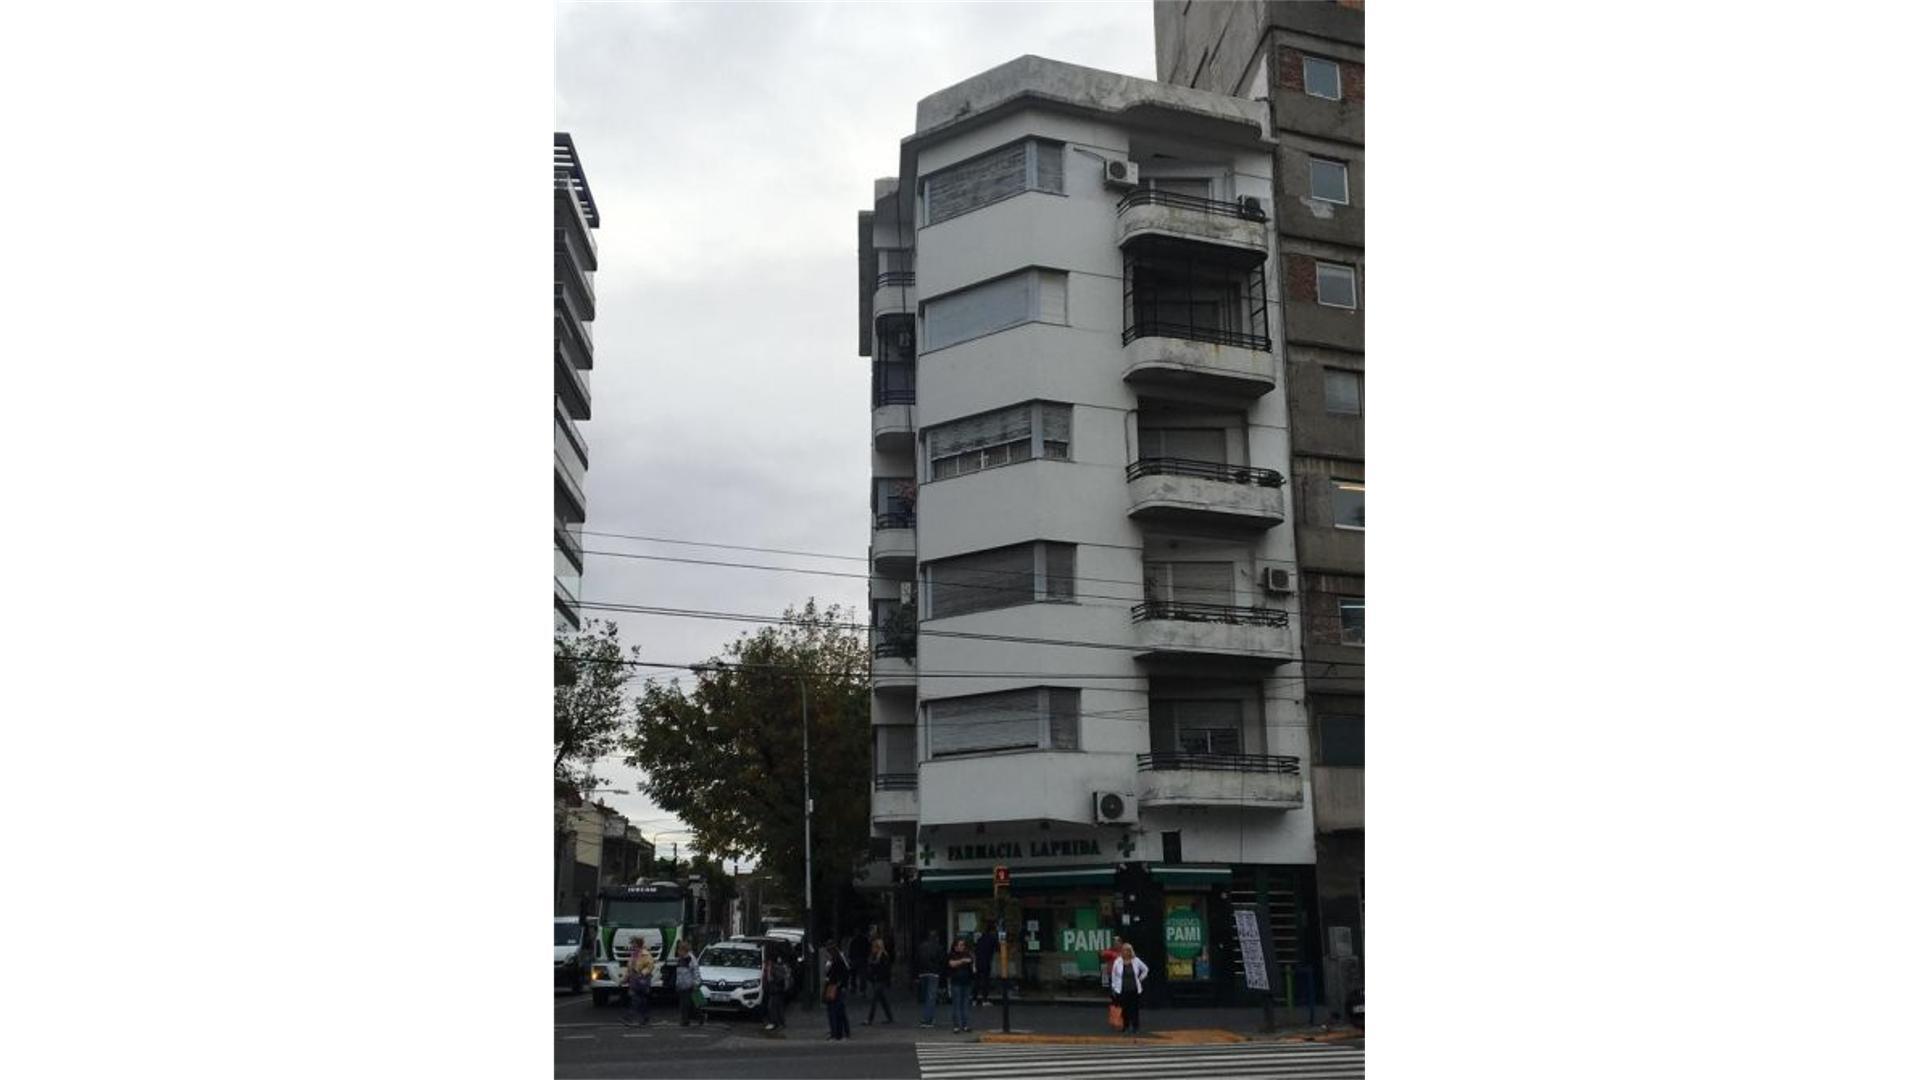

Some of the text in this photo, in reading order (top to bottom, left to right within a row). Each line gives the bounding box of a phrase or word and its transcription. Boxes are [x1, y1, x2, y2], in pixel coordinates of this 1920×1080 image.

[947, 841, 1022, 861] FARMACIA
[1063, 929, 1112, 951] PAMI
[1165, 926, 1201, 941] PAMI
